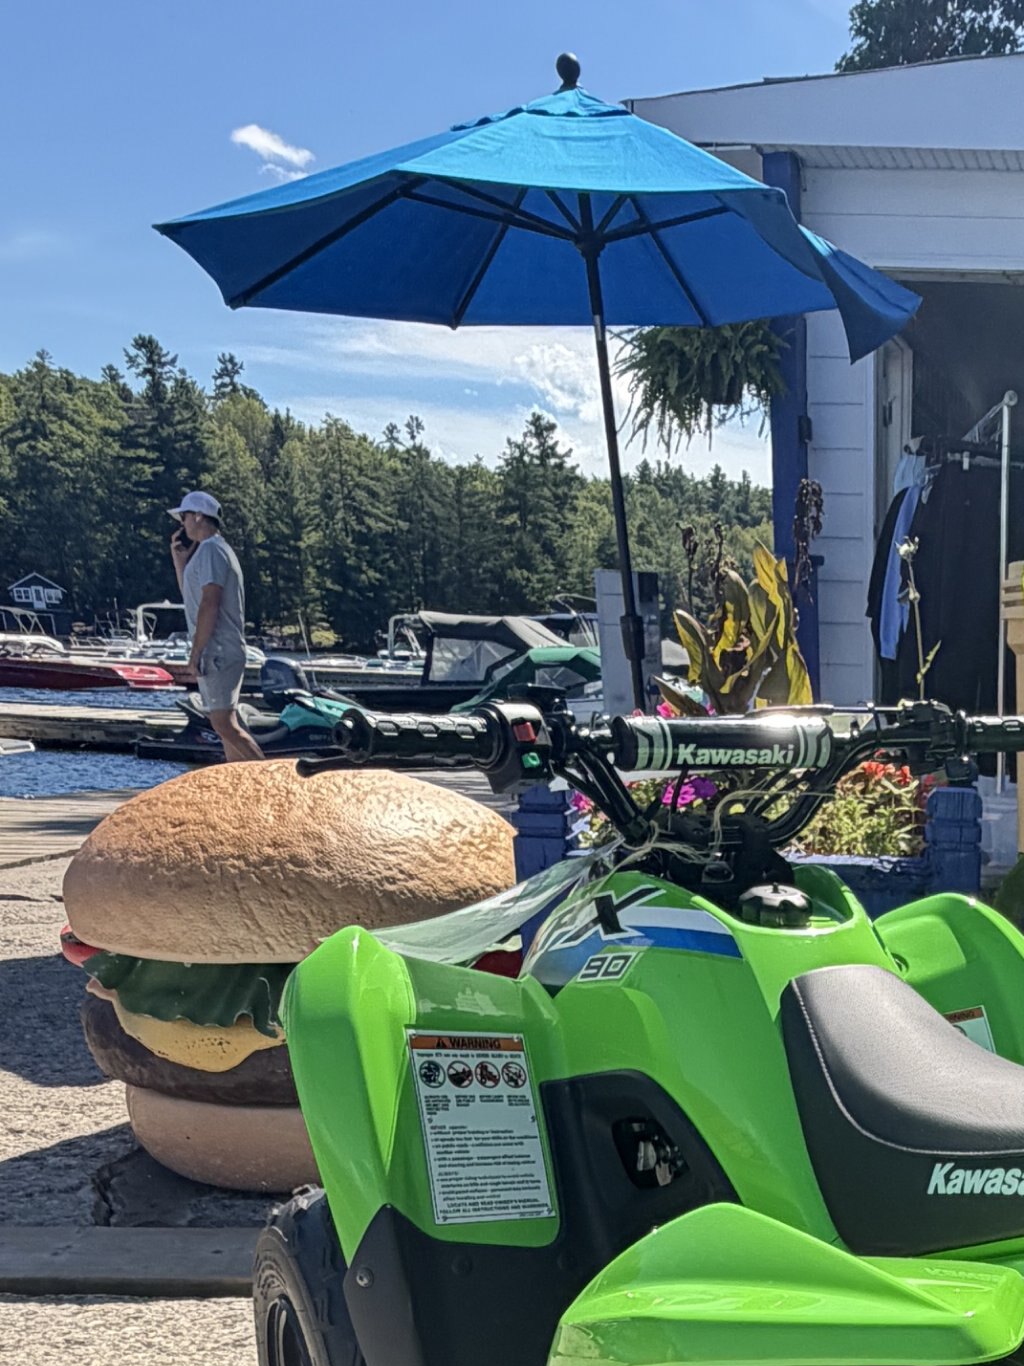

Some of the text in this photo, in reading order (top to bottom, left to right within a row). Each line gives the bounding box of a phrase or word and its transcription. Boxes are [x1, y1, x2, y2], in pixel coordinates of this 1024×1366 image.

[677, 744, 794, 765] Kawasaki
[577, 952, 637, 981] 90
[448, 1037, 502, 1050] WARNING
